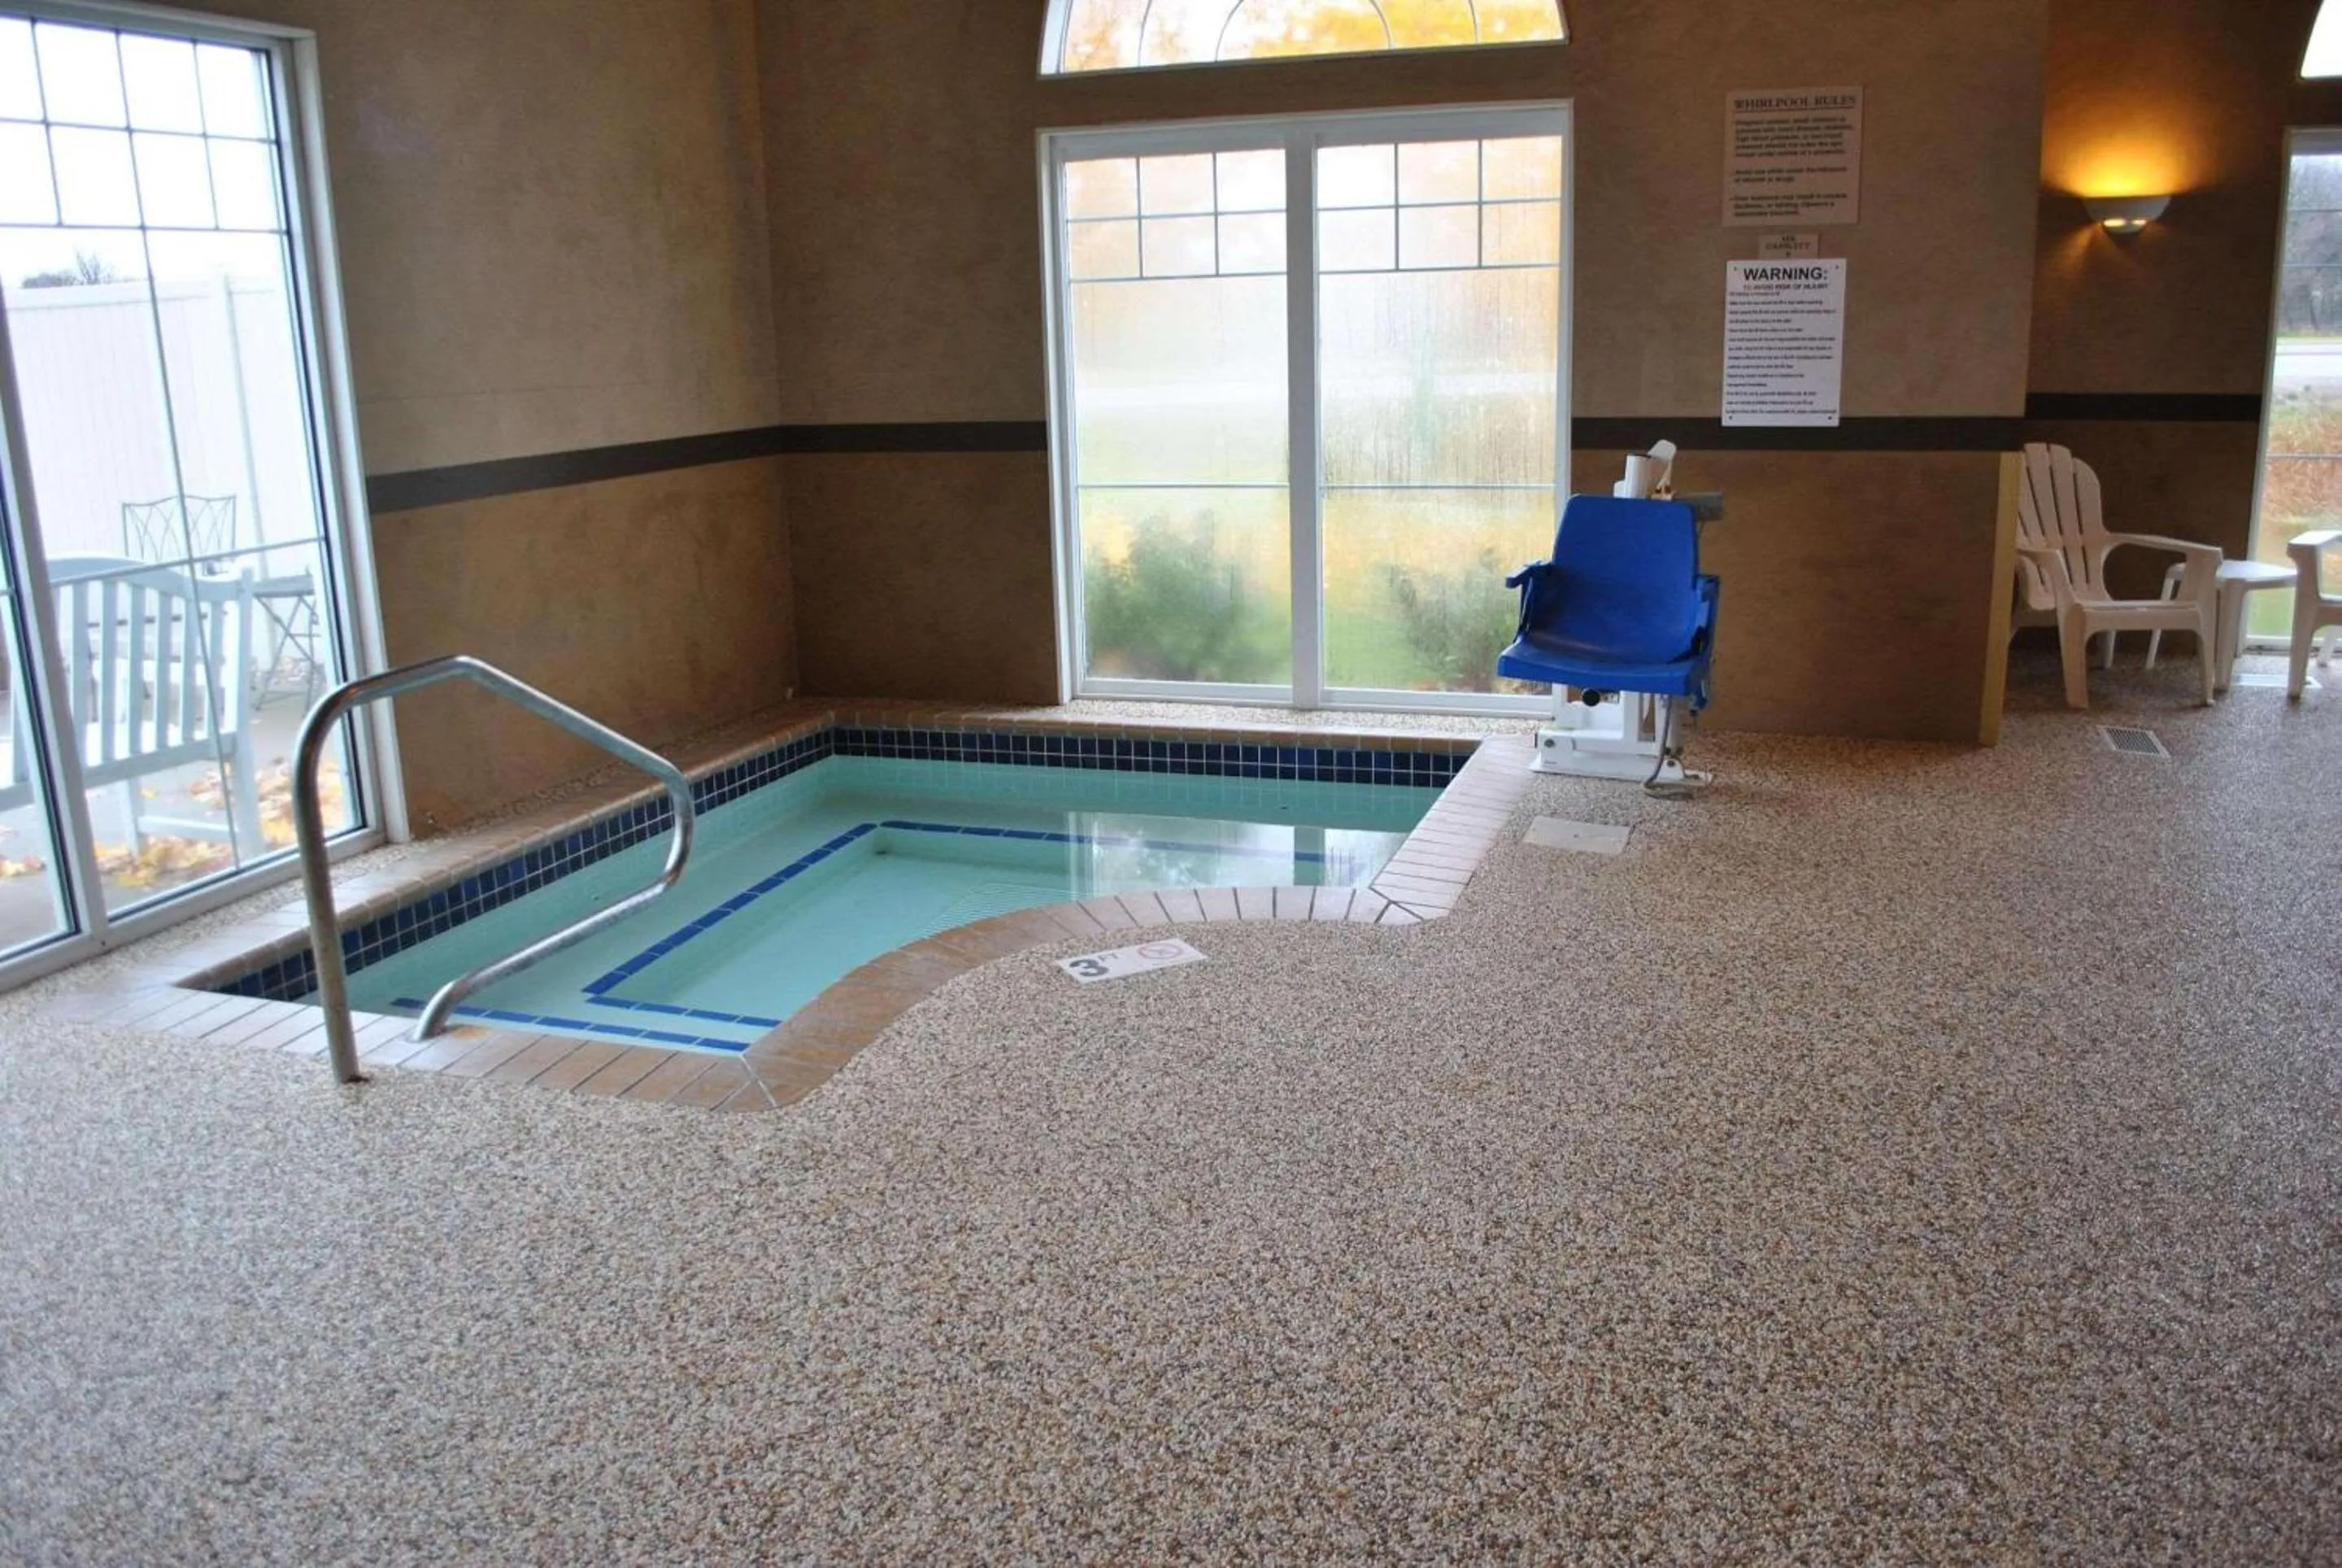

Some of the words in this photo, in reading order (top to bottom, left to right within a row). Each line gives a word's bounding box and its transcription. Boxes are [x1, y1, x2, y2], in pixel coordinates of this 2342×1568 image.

[1734, 96, 1809, 108] WHIRLPOOL
[1814, 94, 1856, 106] RULES
[1743, 266, 1828, 281] WARNING:
[1069, 959, 1109, 977] 3
